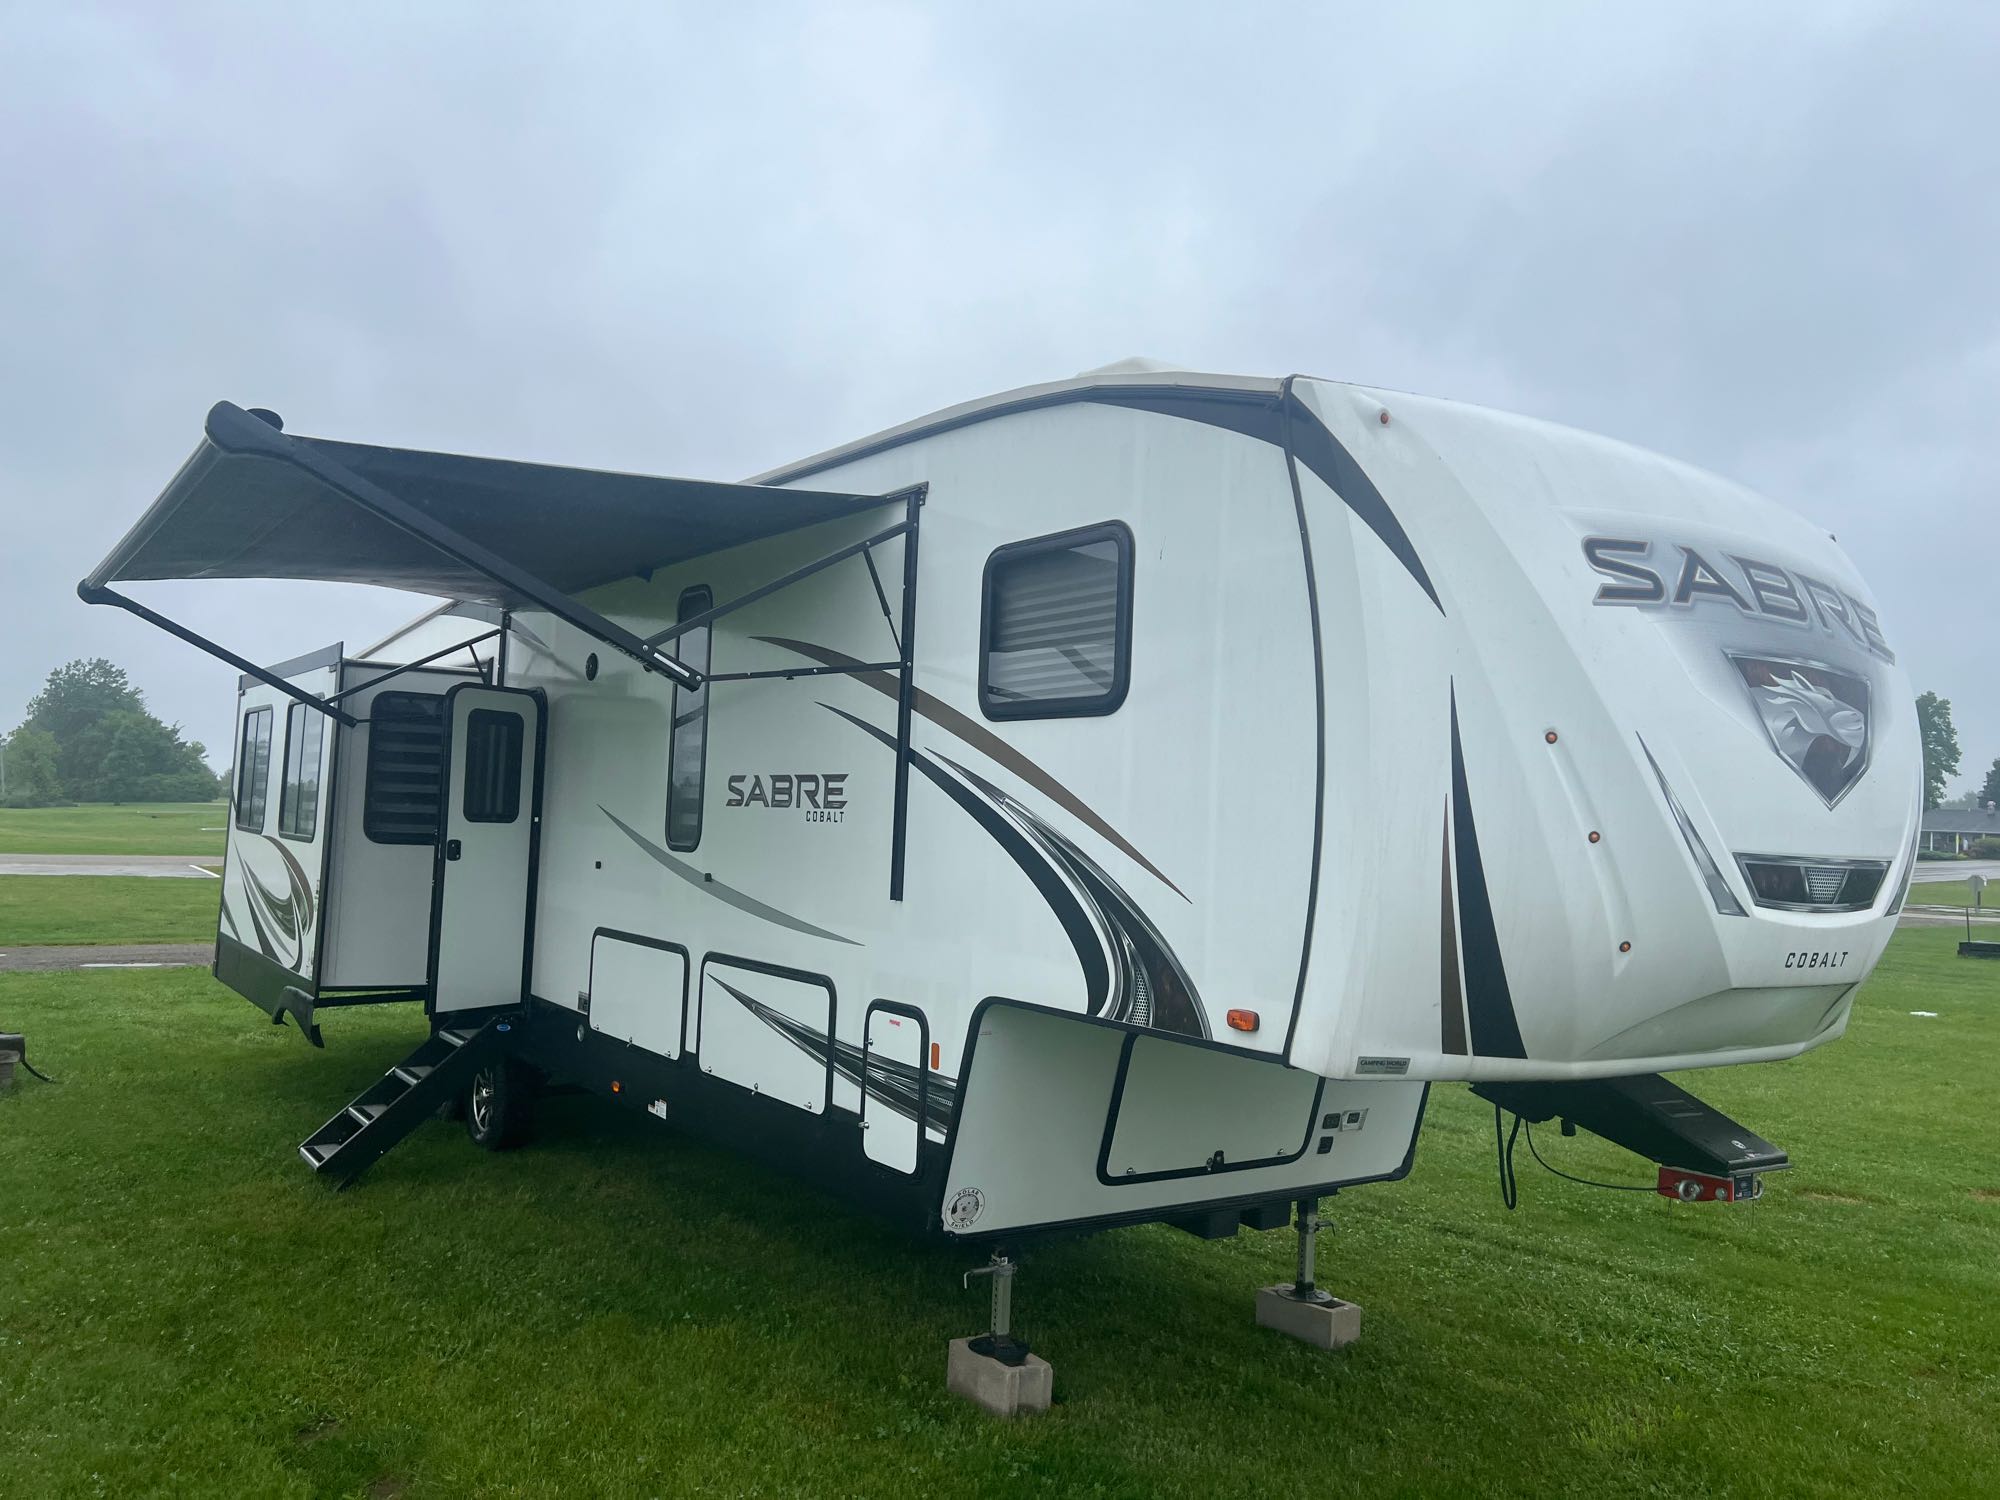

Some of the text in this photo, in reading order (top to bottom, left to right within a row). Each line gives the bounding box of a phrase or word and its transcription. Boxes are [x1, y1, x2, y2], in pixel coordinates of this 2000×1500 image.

[1581, 535, 1896, 666] SABRE
[726, 773, 849, 809] SABRE
[805, 811, 845, 823] COBALT
[1785, 952, 1848, 968] COBALT
[951, 1220, 974, 1228] SHIELD
